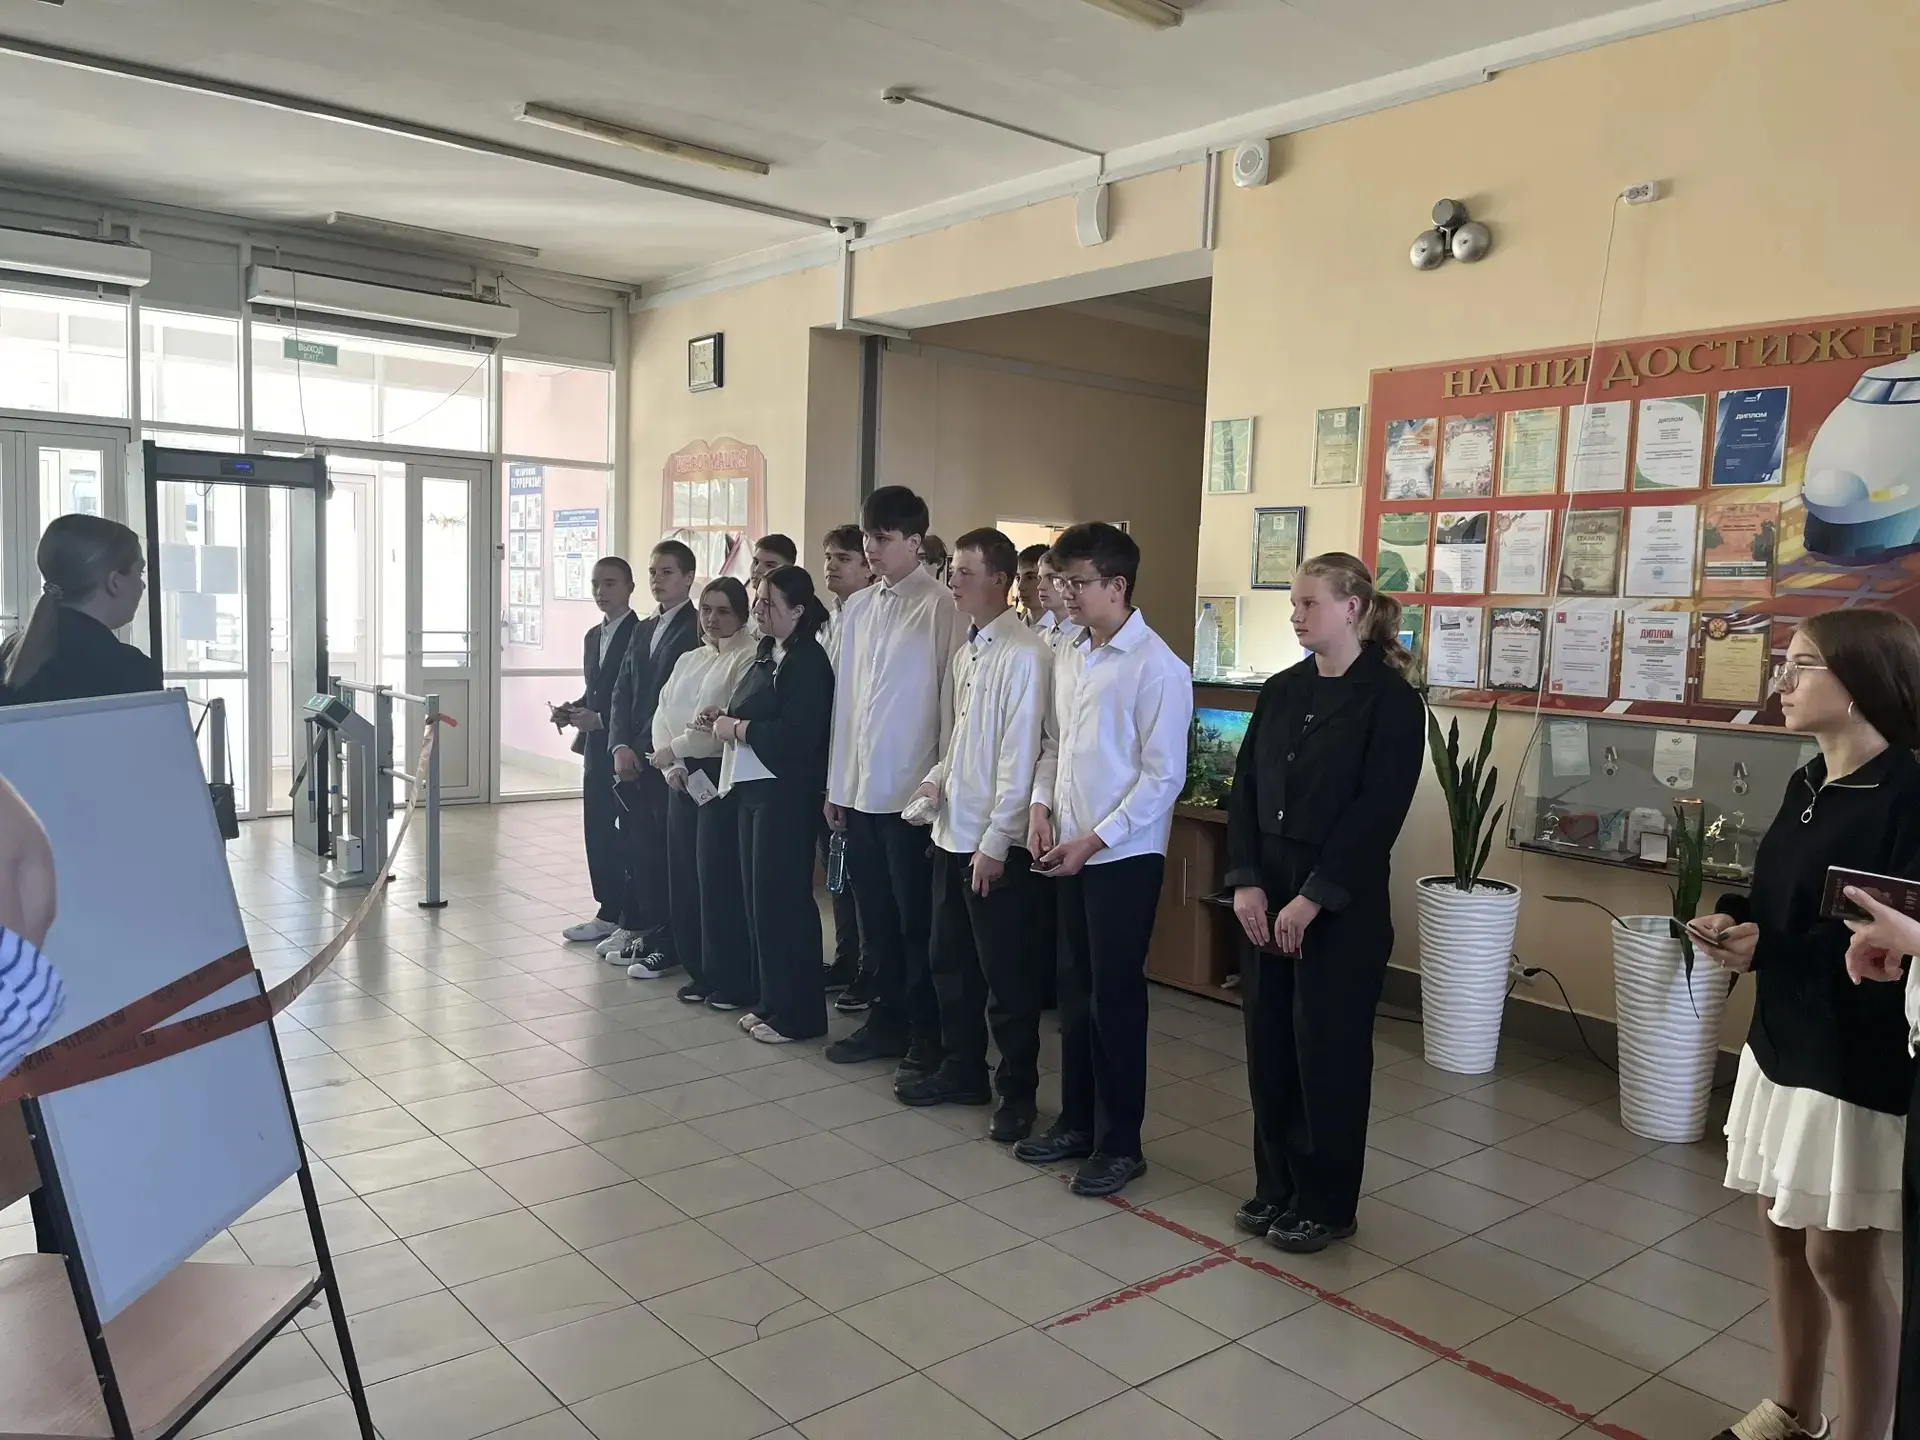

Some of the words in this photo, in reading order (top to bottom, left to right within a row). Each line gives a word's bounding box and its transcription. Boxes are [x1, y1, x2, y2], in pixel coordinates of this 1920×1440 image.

[298, 343, 324, 356] ВЫХОД
[303, 353, 319, 361] EXIT
[1442, 355, 1591, 399] НАШИ
[1657, 416, 1684, 424] ДИПЛОМ
[1735, 412, 1768, 420] ДИПЛОМ
[1640, 629, 1673, 639] ДИПЛОМ
